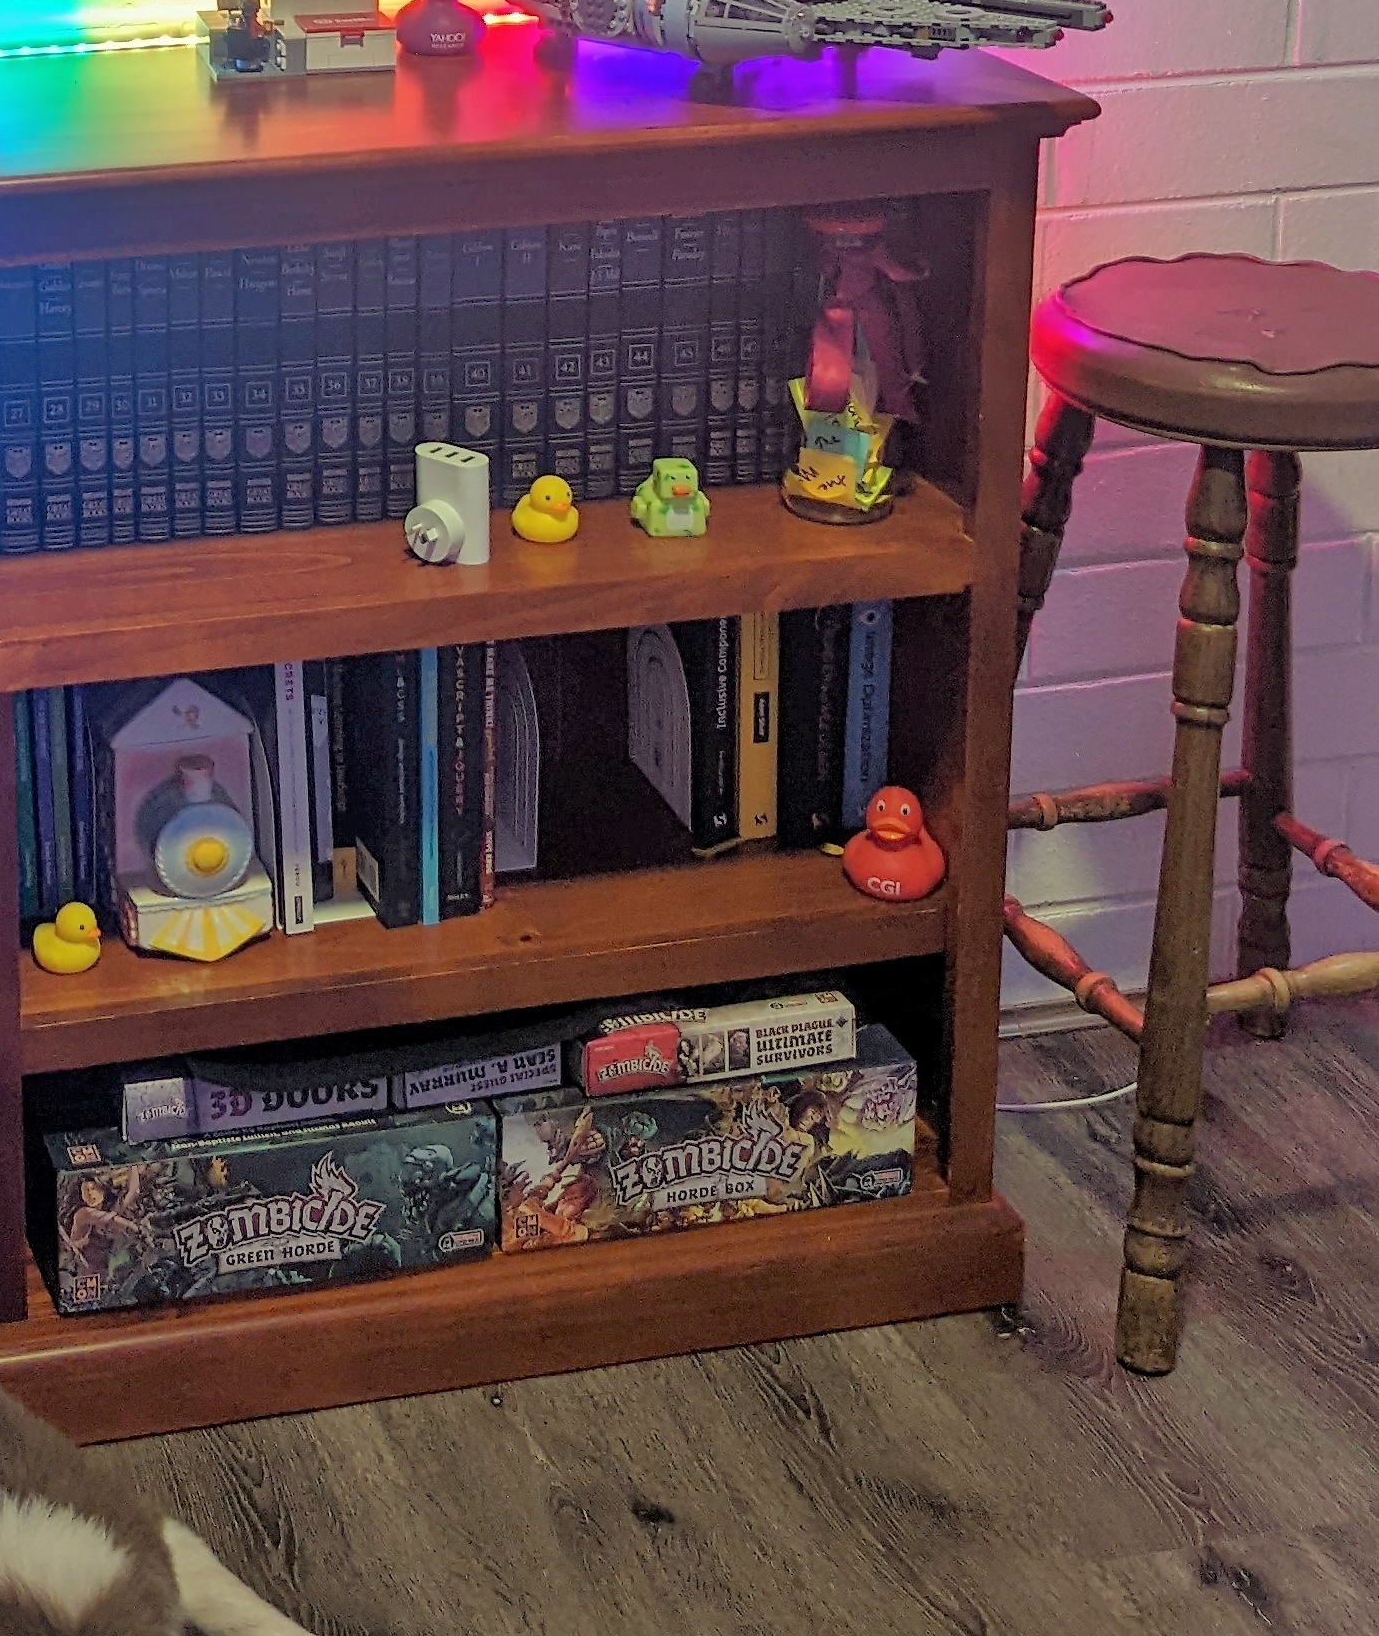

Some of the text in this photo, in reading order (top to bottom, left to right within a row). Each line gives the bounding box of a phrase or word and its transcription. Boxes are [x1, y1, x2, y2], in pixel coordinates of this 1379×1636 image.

[716, 675, 728, 729] Inclusive
[867, 877, 901, 896] CGI
[755, 1019, 833, 1038] BLACK PLAGUE
[756, 1030, 832, 1053] ULTIMATE
[756, 1044, 833, 1066] SURVIVORS
[597, 1058, 670, 1083] ZOMBICIDE
[209, 1078, 378, 1122] 3D DOORS
[615, 1135, 814, 1206] ZOMBICIDE
[666, 1178, 755, 1204] HORDE BOX
[172, 1193, 388, 1266] ZOMBICIDE
[225, 1240, 336, 1267] GREEN HORDE
